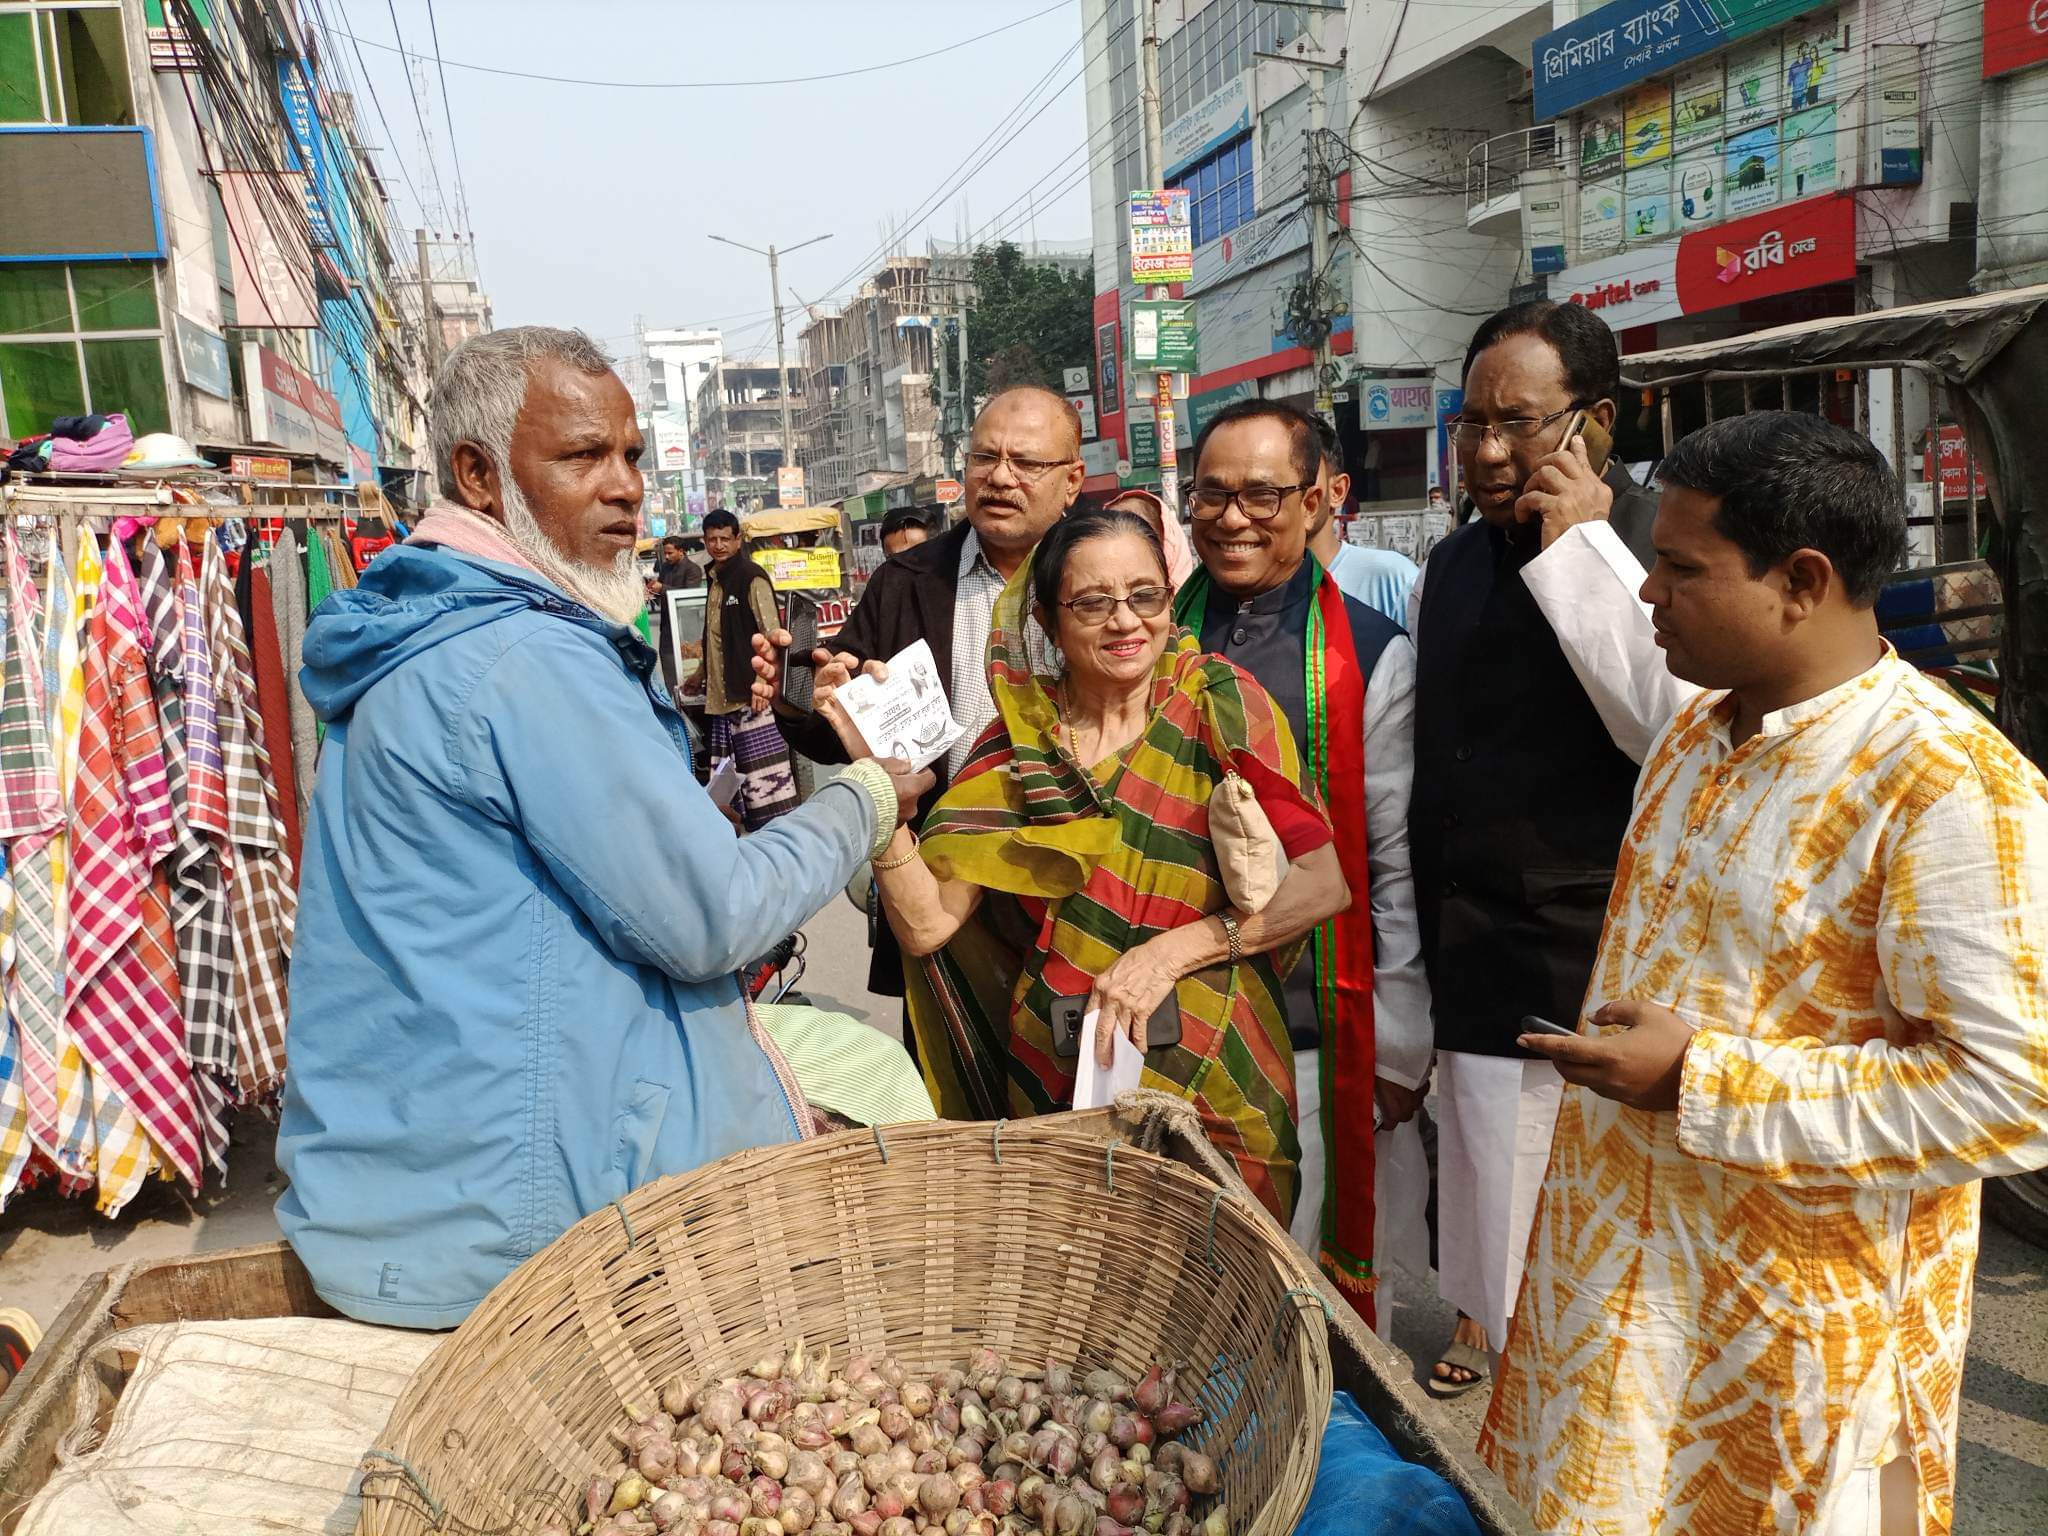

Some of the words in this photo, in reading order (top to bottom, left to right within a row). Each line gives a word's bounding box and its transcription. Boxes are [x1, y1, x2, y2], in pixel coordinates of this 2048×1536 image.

[1543, 29, 1616, 83] প্রিমিয়ার
[1621, 1, 1681, 46] ব্যাংক
[1624, 44, 1653, 69] সেবাই
[1743, 230, 1785, 275] রবি
[1585, 278, 1632, 310] airtel
[1634, 279, 1661, 296] care
